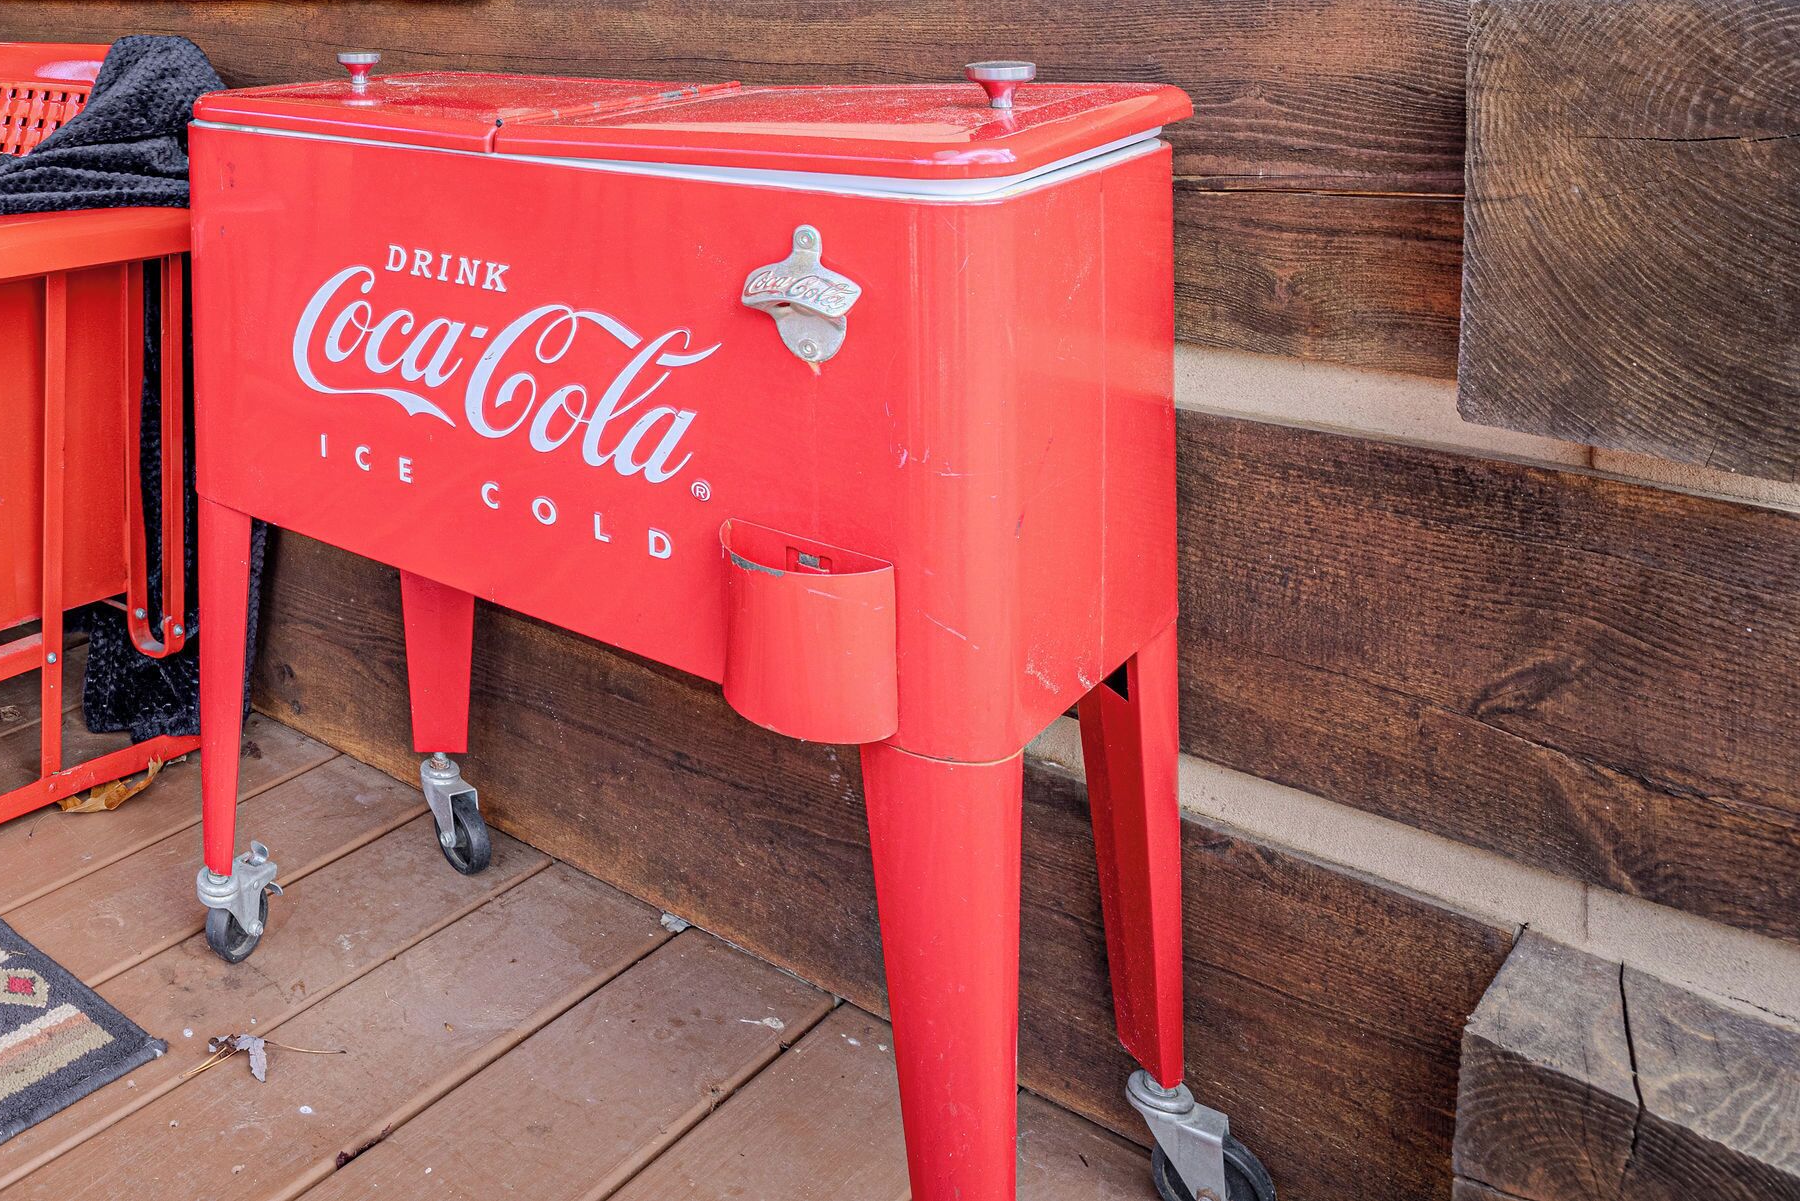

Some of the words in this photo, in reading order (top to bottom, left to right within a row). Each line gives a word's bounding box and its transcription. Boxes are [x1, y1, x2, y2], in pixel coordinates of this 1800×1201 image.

[384, 243, 510, 293] DRINK
[744, 270, 858, 310] Coca-Cola
[292, 264, 722, 484] Coca-Cola
[319, 433, 413, 485] ICE
[480, 481, 673, 560] COLD
